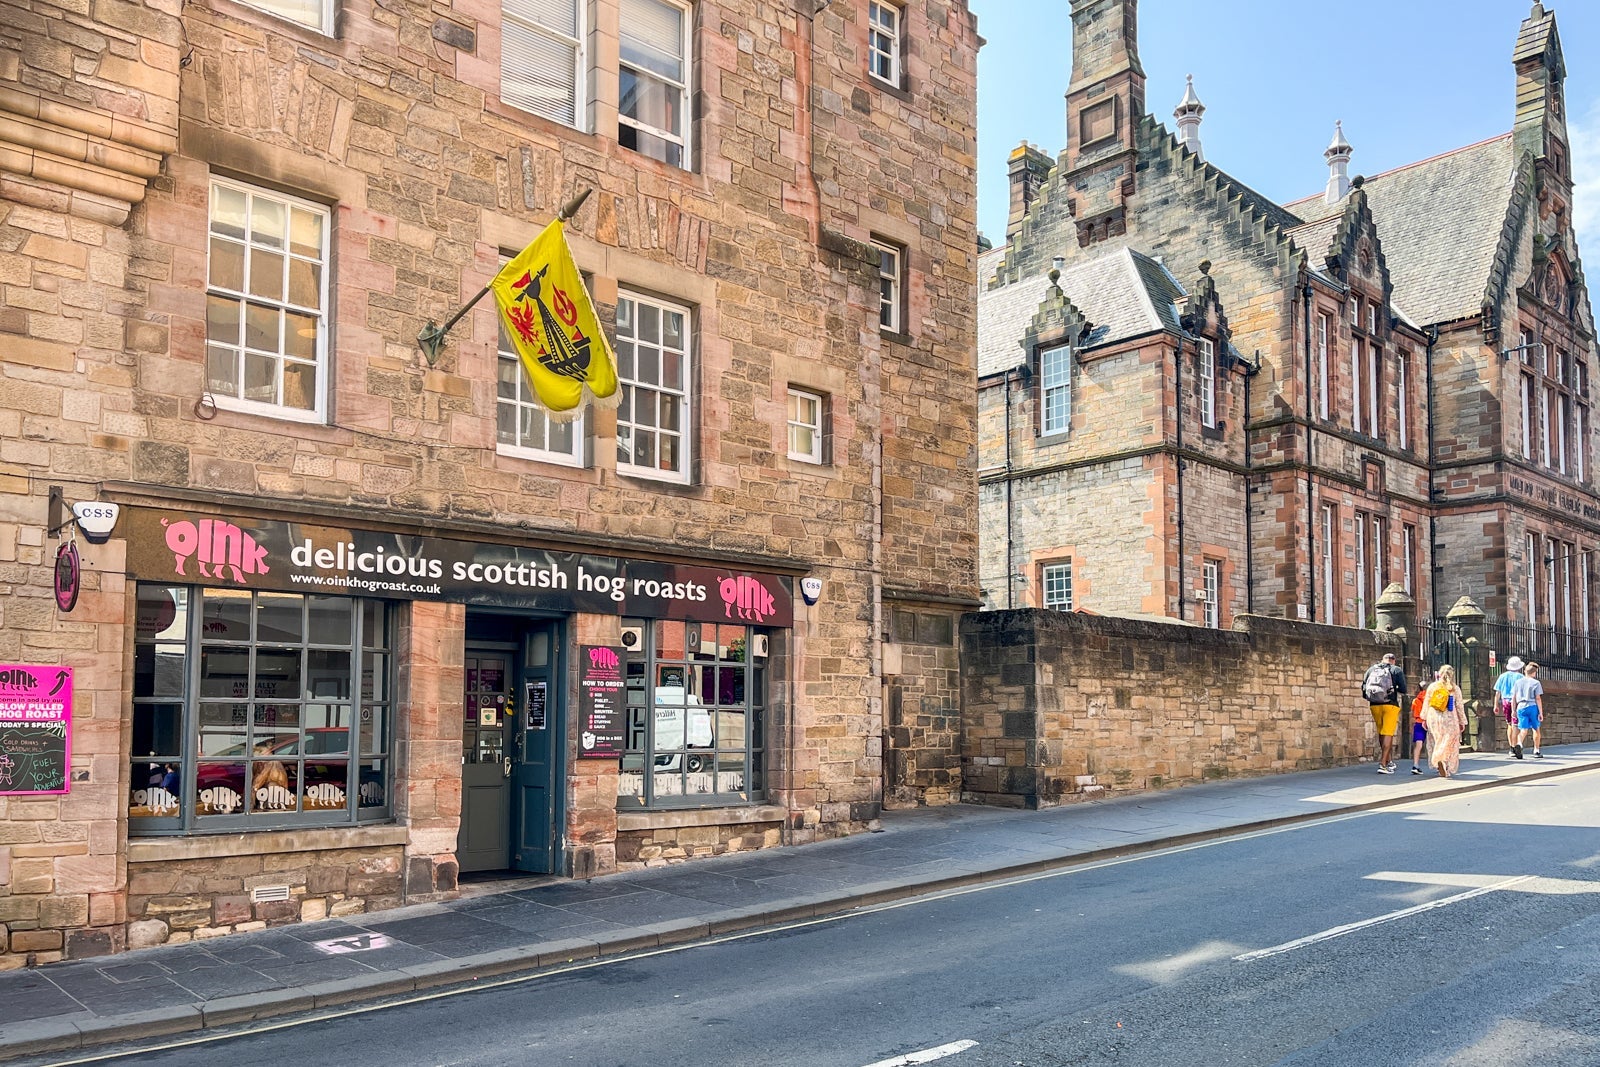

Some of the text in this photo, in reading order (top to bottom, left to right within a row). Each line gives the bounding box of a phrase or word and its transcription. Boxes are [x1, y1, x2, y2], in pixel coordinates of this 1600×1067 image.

[290, 539, 707, 602] delicious scottish hog roasts
[290, 573, 441, 595] www.oinkhogroast.co.uk
[28, 703, 64, 711] PULLED
[0, 710, 63, 719] HOG ROAST
[32, 757, 57, 770] FUEL
[29, 768, 60, 783] YOUR
